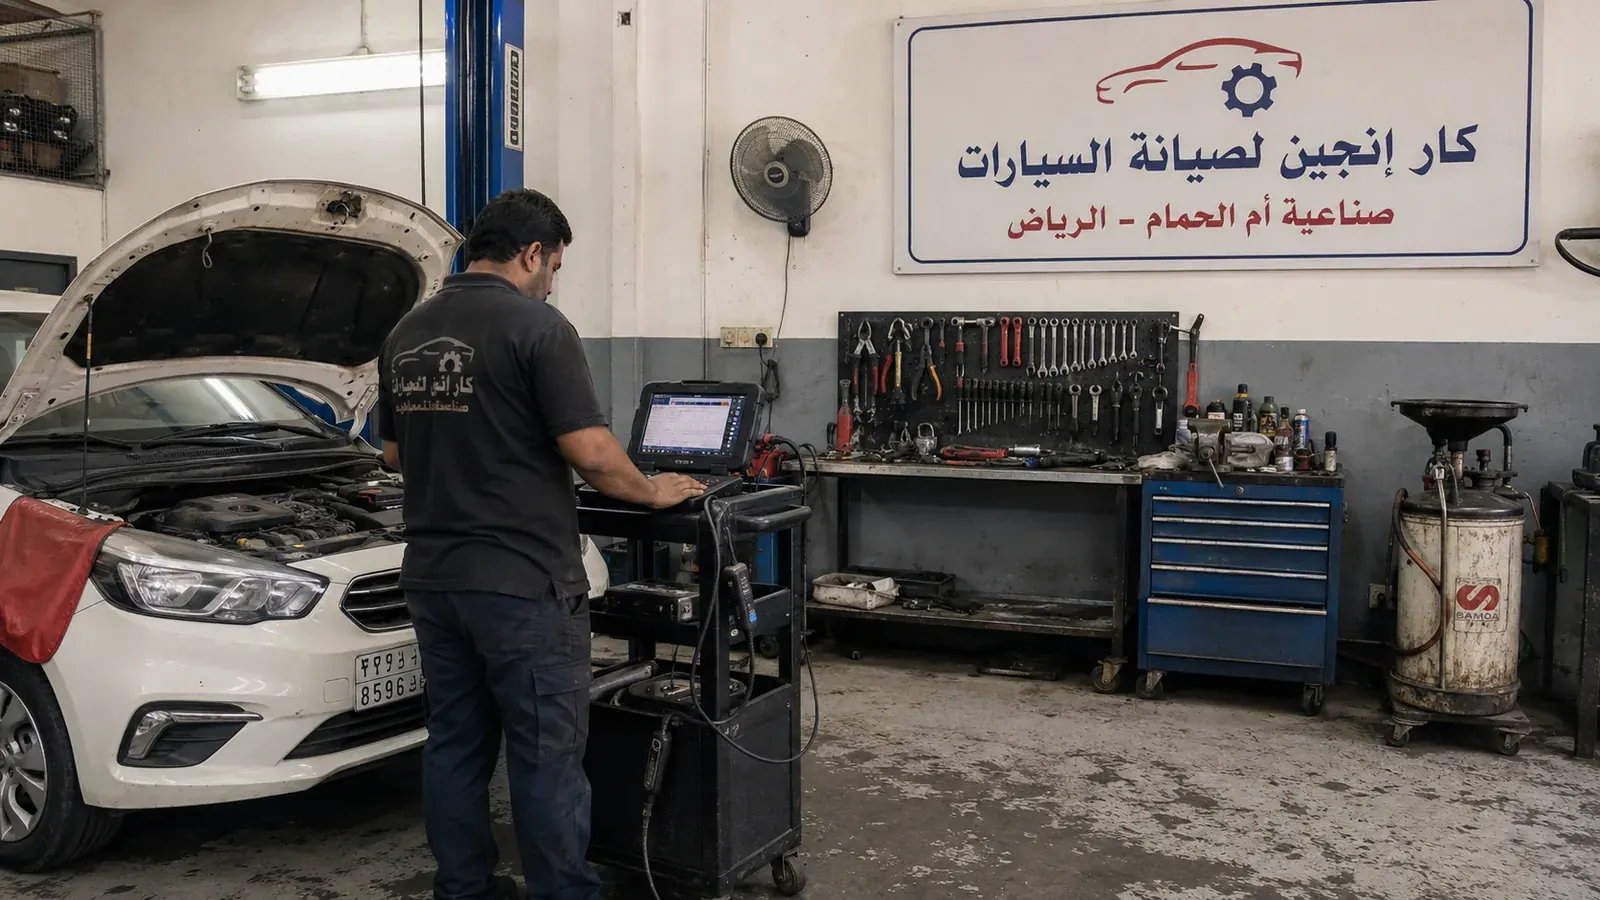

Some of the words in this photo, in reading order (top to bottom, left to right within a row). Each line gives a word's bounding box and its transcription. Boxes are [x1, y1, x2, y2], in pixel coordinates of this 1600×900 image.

[958, 137, 1112, 189] السيارات
[1129, 131, 1265, 184] لصيانة
[1279, 127, 1393, 180] إنجين
[1408, 124, 1479, 176] كار
[1007, 205, 1107, 240] الرياض
[1147, 203, 1236, 239] الحمام
[1245, 194, 1272, 237] أم
[1281, 198, 1395, 235] صناعية
